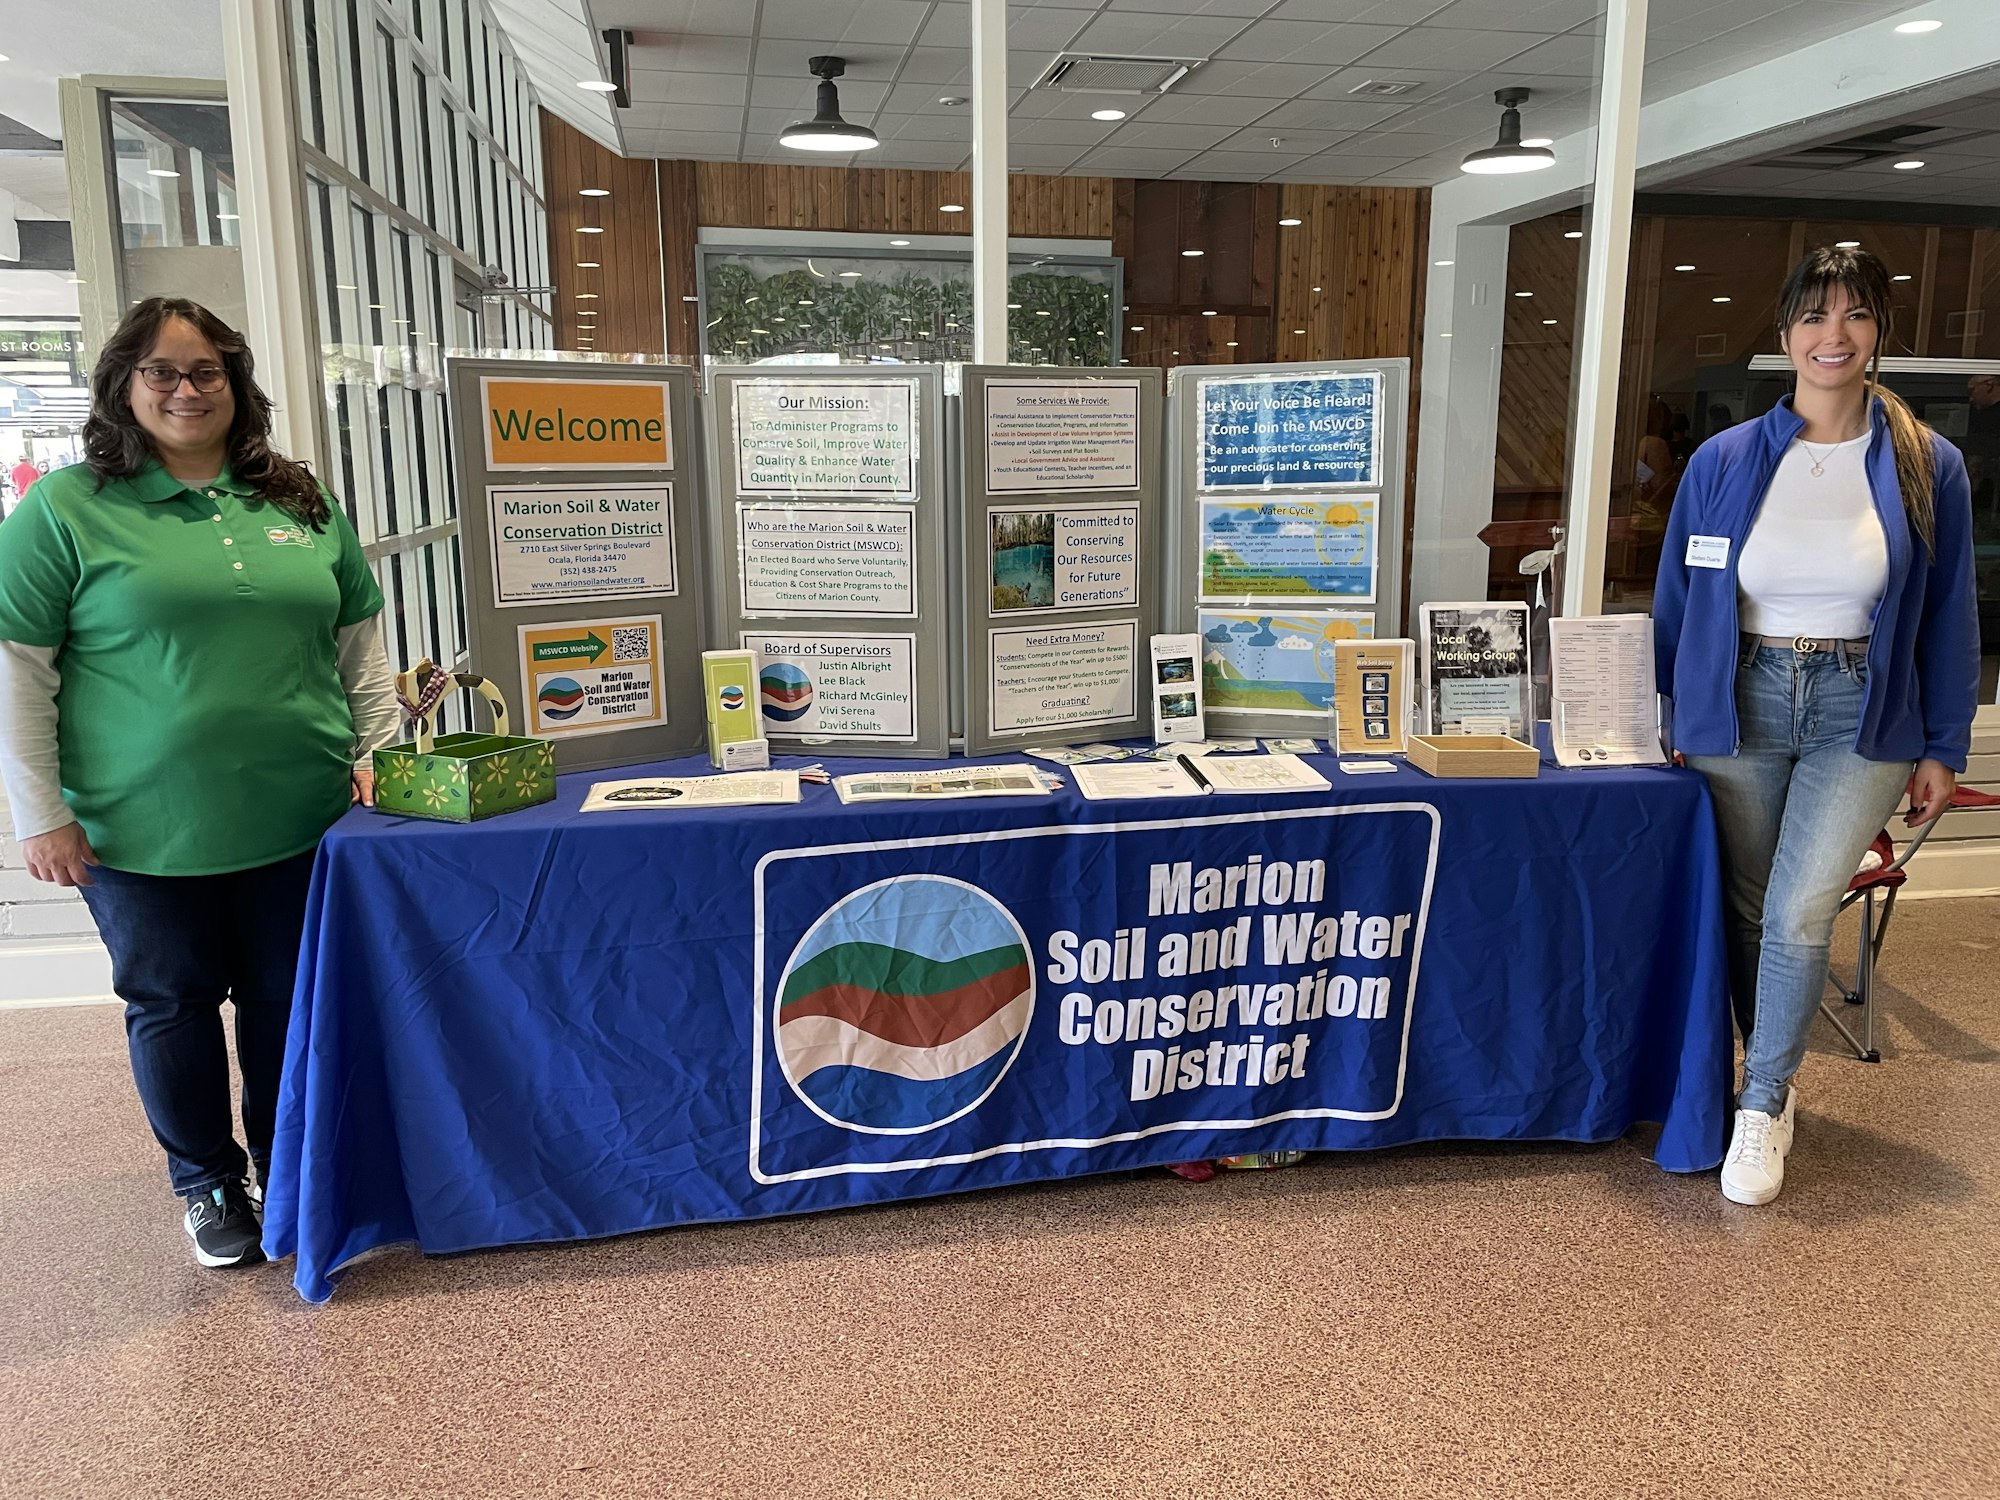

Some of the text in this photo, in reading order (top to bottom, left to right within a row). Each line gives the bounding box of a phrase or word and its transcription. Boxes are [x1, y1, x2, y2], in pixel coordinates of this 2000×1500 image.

[0, 342, 71, 351] ST ROOMS
[778, 396, 869, 409] Our Mission:
[1207, 393, 1371, 412] Let Your Voice Be Heard!
[492, 408, 662, 442] Welcome
[751, 421, 898, 434] To Administer Programs to
[1212, 418, 1365, 435] Come Join the MSWCD
[743, 438, 908, 452] Conserve Soil, Improve Water
[1210, 446, 1223, 455] Be
[1241, 444, 1288, 454] advocate
[1291, 443, 1306, 452] for
[1309, 442, 1366, 452] conserving
[755, 456, 895, 468] Quality & Enhance Water
[1231, 463, 1274, 474] precious
[1277, 461, 1299, 470] land
[1302, 461, 1311, 471] &
[1314, 461, 1365, 470] resources
[750, 472, 901, 485] Quantity in Marion County.
[504, 499, 660, 515] Marion Soil & Water
[1258, 506, 1314, 516] Water Cycle
[503, 522, 663, 539] Conservation District
[748, 522, 769, 531] Who
[790, 523, 806, 531] the
[808, 523, 844, 532] Marion
[846, 523, 864, 532] Soil
[867, 524, 874, 532] &
[877, 524, 906, 533] Water
[752, 540, 903, 551] Conservation District (MSWCD):
[1066, 534, 1124, 547] Conserving
[520, 541, 650, 554] 2710 East Silver Springs Boulevard
[549, 554, 626, 564] Ocala, Florida 34470
[760, 555, 789, 564] Elected
[791, 556, 815, 564] Board
[862, 557, 909, 568] Voluntarily,
[1057, 553, 1132, 565] Our Resources
[560, 566, 616, 576] (352) 438-2475
[760, 568, 896, 579] Providing Conservation Outreach,
[531, 576, 645, 590] www.marionsoilandwater.org
[1069, 572, 1120, 583] for Future
[748, 580, 788, 588] Education
[798, 580, 816, 589] Cost
[818, 581, 841, 589] Share
[843, 581, 882, 591] Programs
[776, 592, 806, 600] Citizens
[818, 593, 848, 601] Marion
[850, 593, 881, 602] County.
[1026, 632, 1104, 646] Need Extra Money?
[1437, 634, 1465, 644] Local
[539, 644, 598, 655] MSWCD Website
[765, 643, 891, 656] Board of Supervisors
[1437, 651, 1516, 662] Working Group
[819, 661, 891, 673] Justin Albright
[601, 672, 633, 682] Marion
[819, 677, 866, 686] Lee Black
[585, 681, 650, 695] Soil and Water
[588, 691, 648, 706] Conservation
[819, 691, 908, 703] Richard McGinley
[1042, 696, 1090, 708] Graduating?
[602, 703, 636, 715] District
[820, 706, 875, 716] Vivi Serena
[1079, 708, 1113, 717] Scholarship!
[820, 720, 881, 730] David Shults
[1148, 854, 1326, 917] Marion
[1047, 910, 1411, 985] Soil and Water
[1058, 969, 1391, 1045] Conservation
[1130, 1033, 1311, 1102] District
